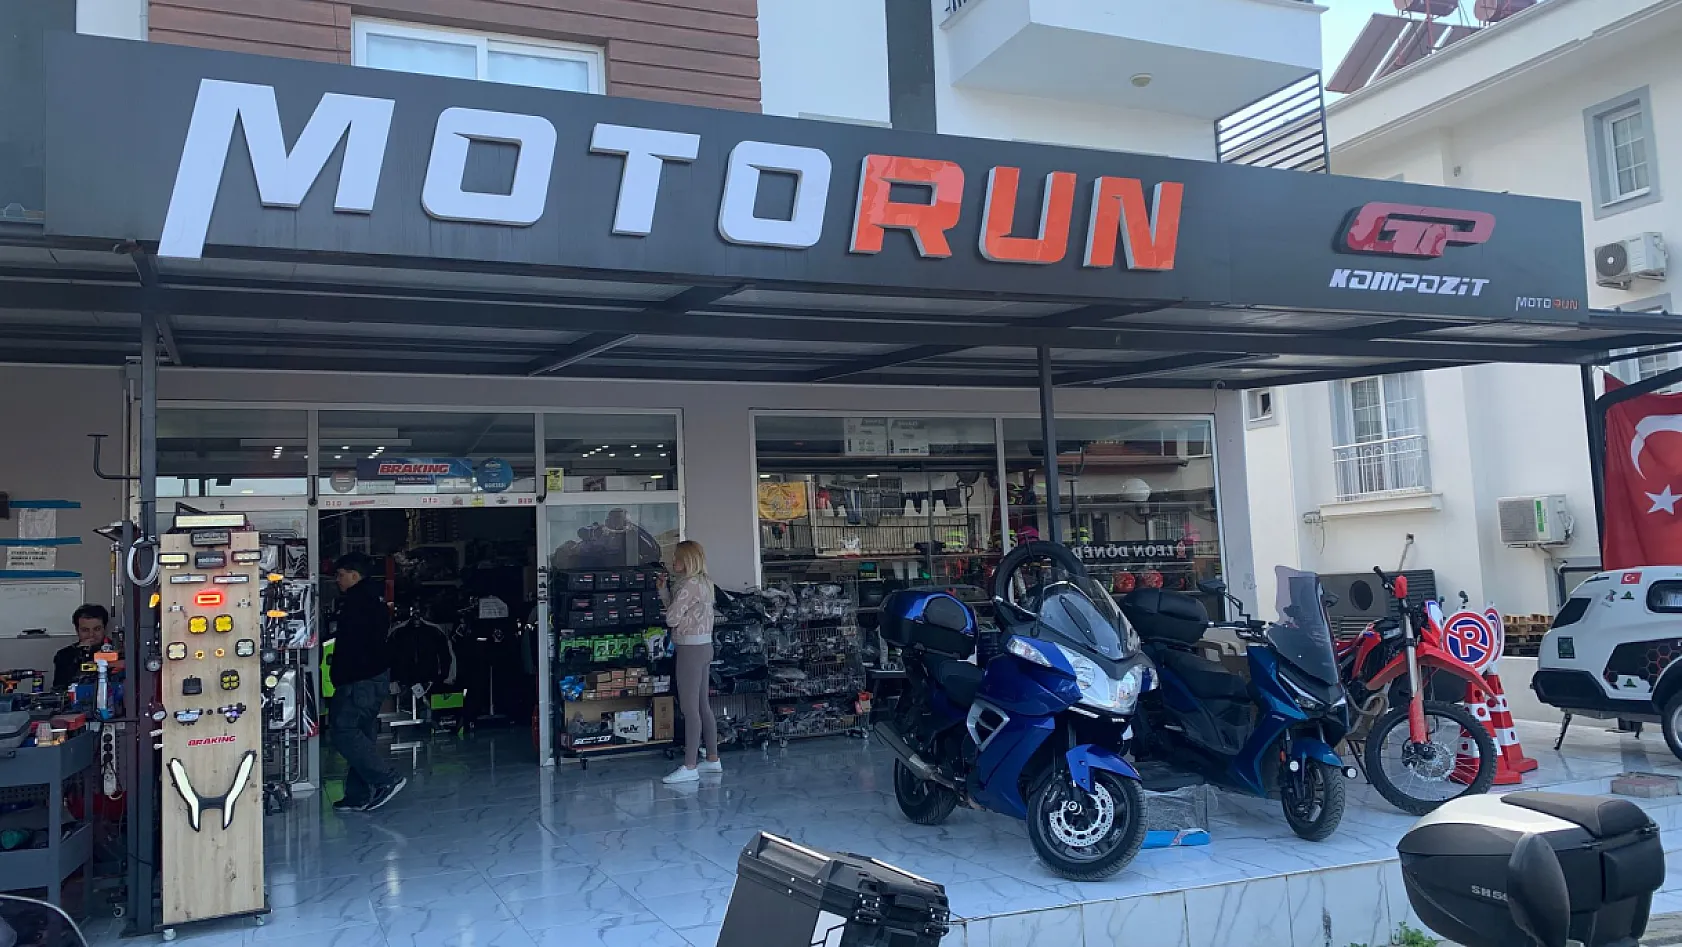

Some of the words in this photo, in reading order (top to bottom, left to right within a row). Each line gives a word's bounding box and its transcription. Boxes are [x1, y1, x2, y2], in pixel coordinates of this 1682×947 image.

[158, 78, 1185, 271] MOTORUN
[378, 462, 450, 476] BRAKING
[187, 735, 236, 747] BRAKING
